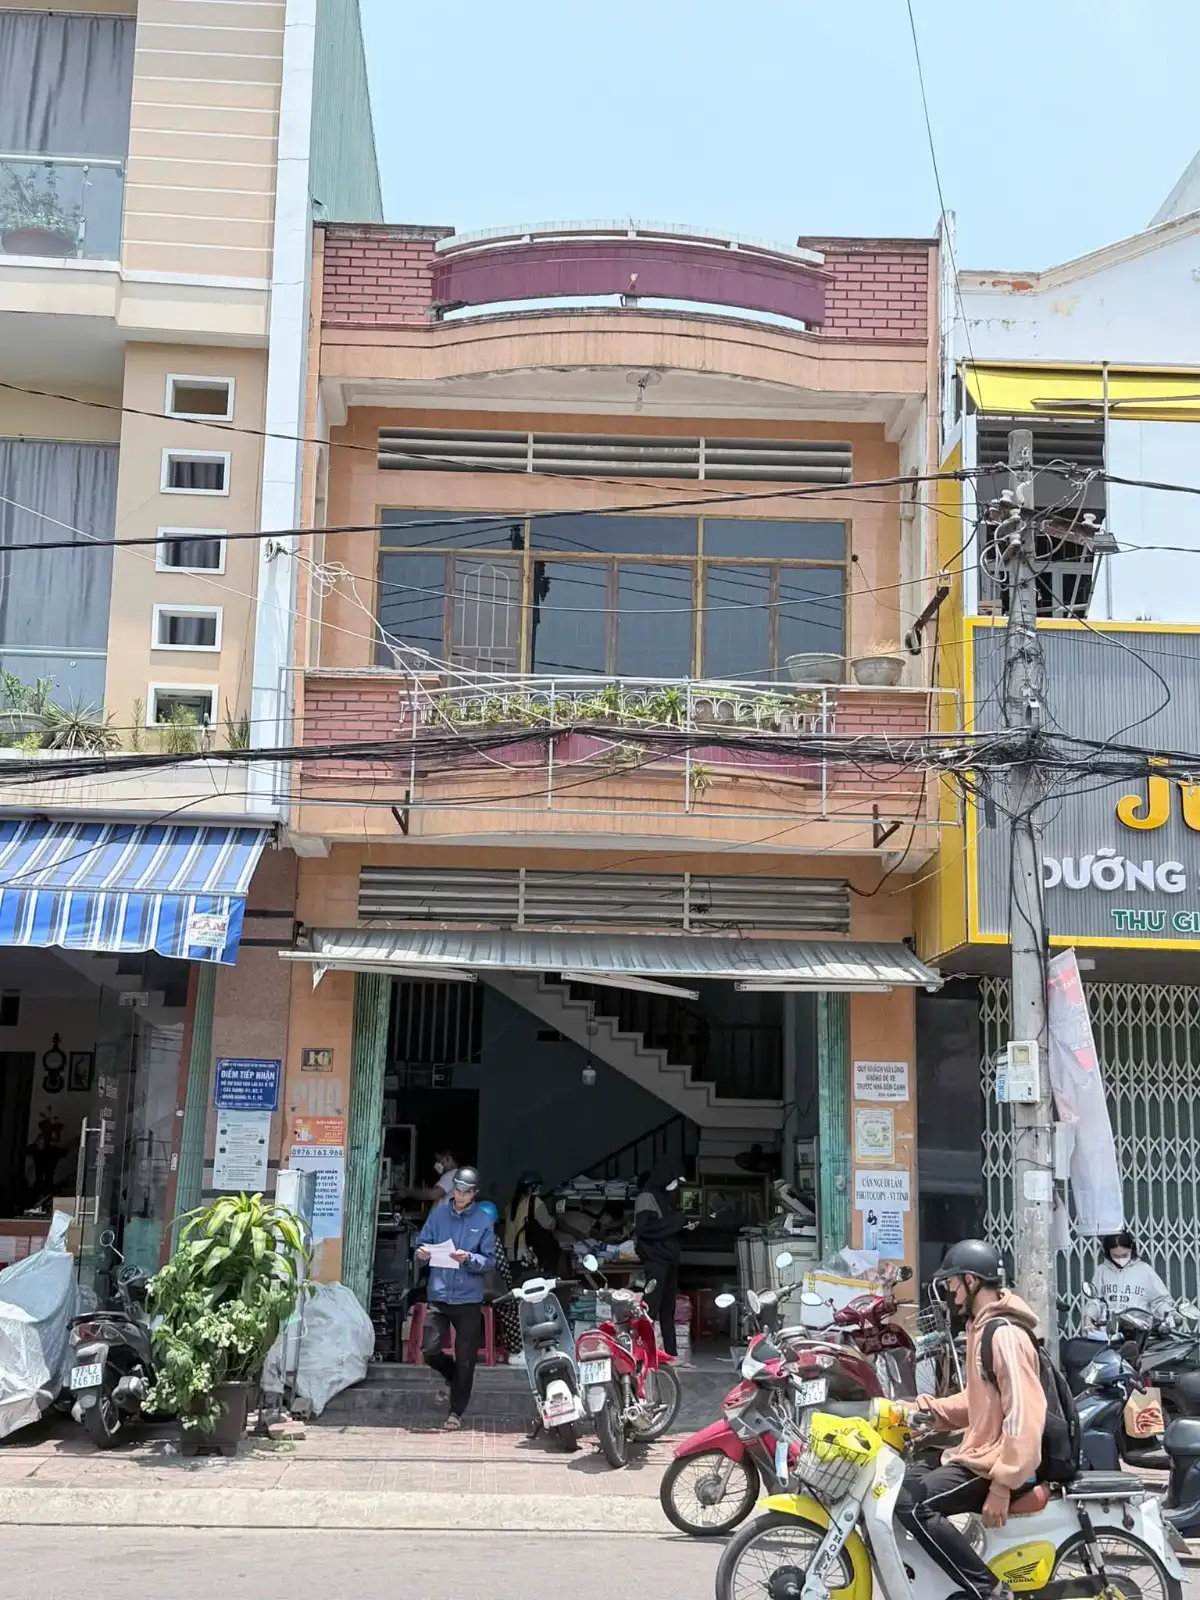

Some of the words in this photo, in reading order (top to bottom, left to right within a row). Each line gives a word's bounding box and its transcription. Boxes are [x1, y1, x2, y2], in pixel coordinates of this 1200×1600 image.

[1043, 847, 1187, 893] DƯỠNG
[1112, 908, 1167, 931] THƯ
[220, 1067, 239, 1079] ĐIỂM
[239, 1068, 255, 1080] TIẾP
[255, 1070, 276, 1082] NHẬN
